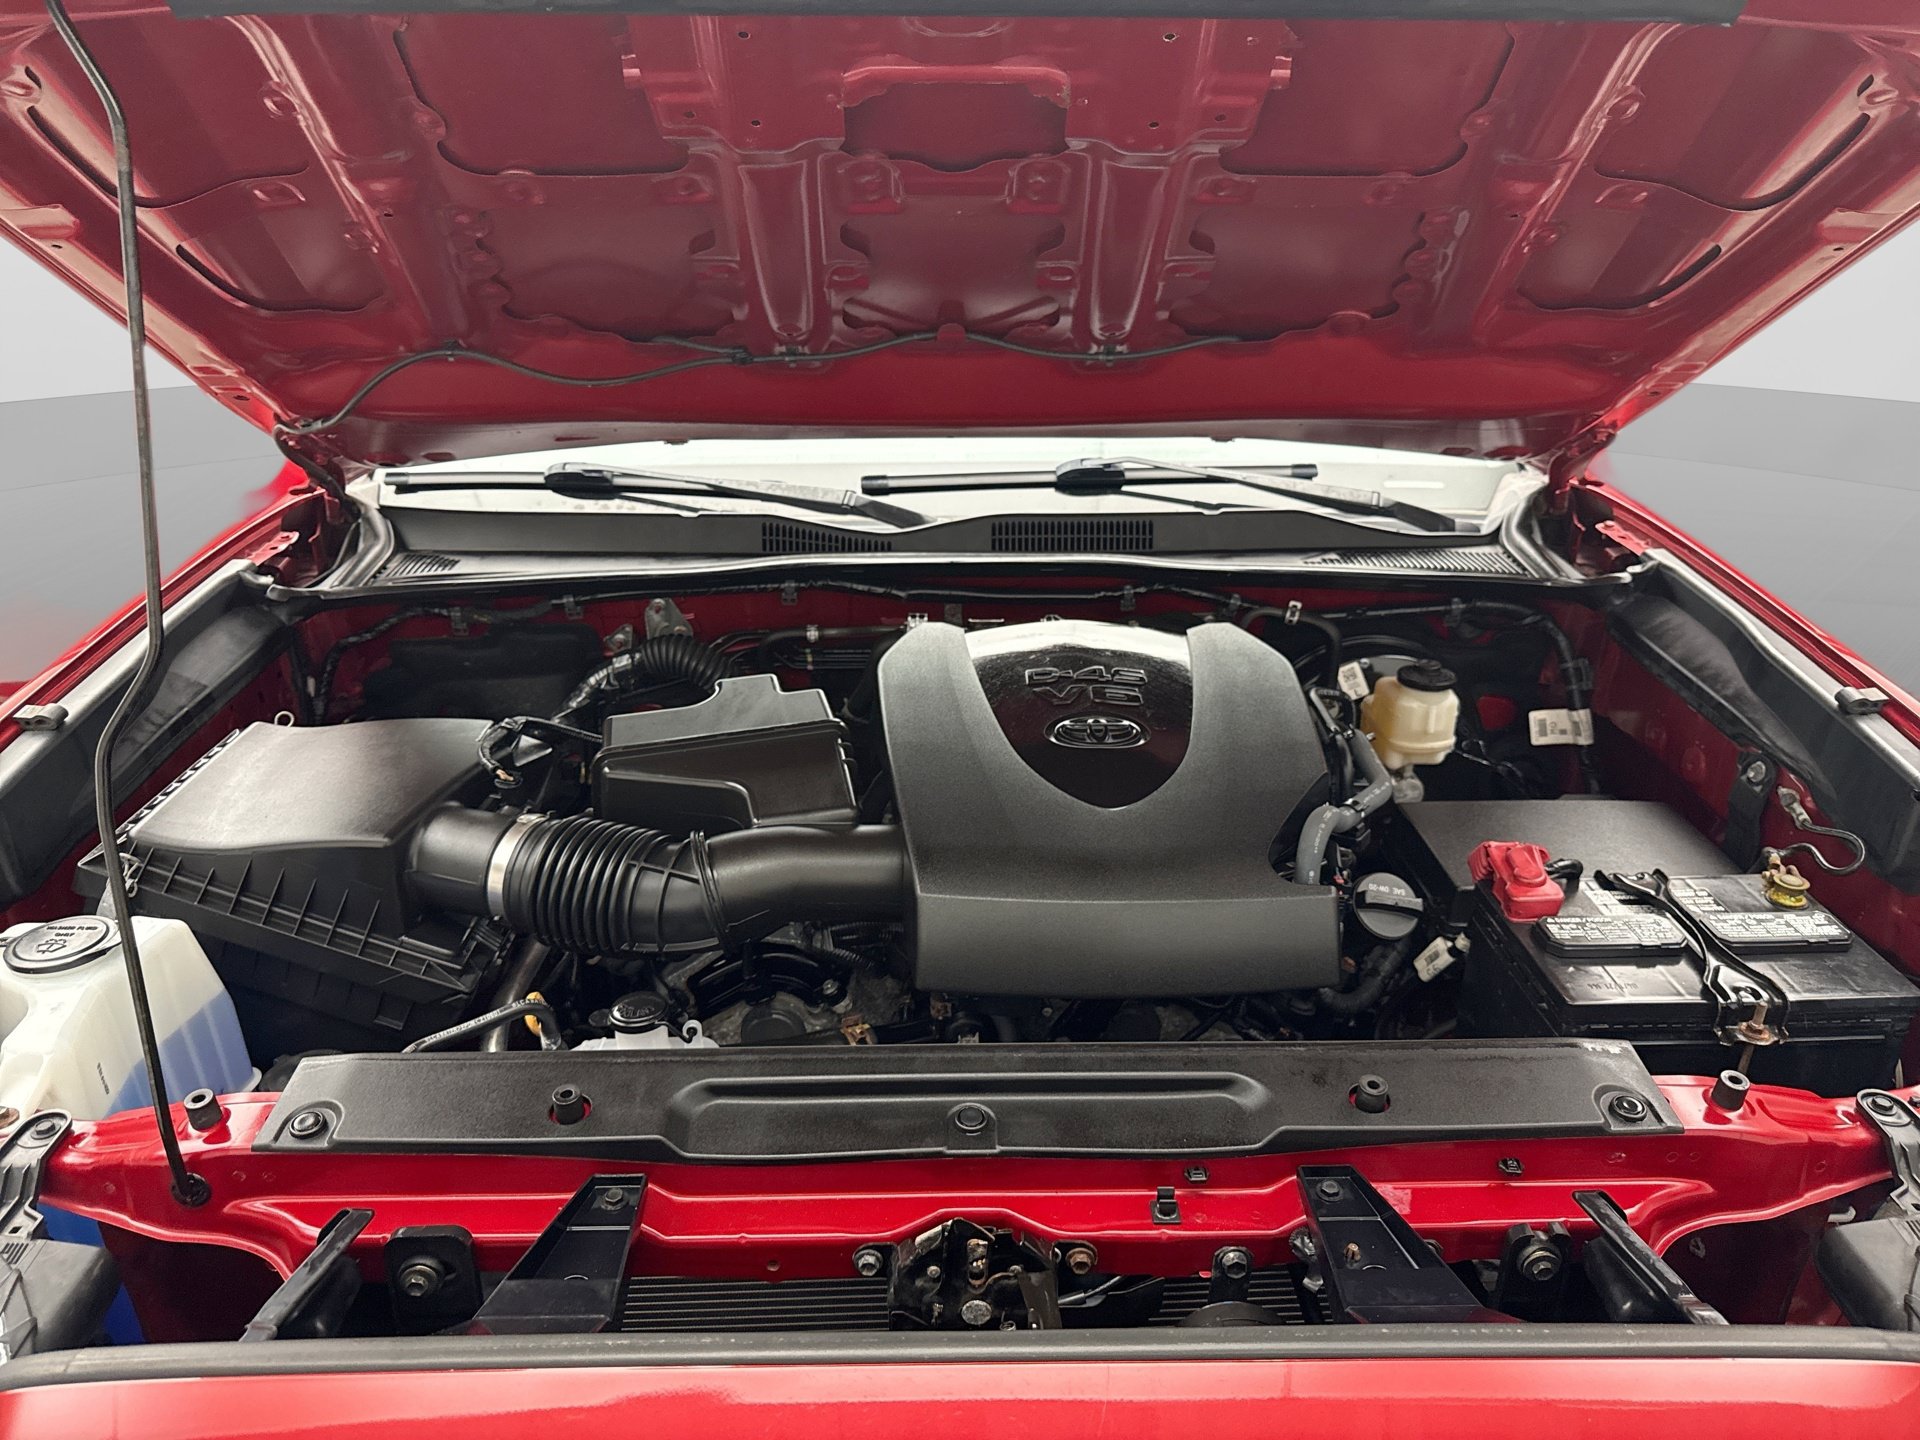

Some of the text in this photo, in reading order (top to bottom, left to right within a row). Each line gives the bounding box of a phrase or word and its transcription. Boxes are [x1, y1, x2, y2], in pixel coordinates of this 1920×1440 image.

[1024, 665, 1148, 685] D-4S
[1032, 684, 1144, 706] V6
[1392, 887, 1406, 896] SAE
